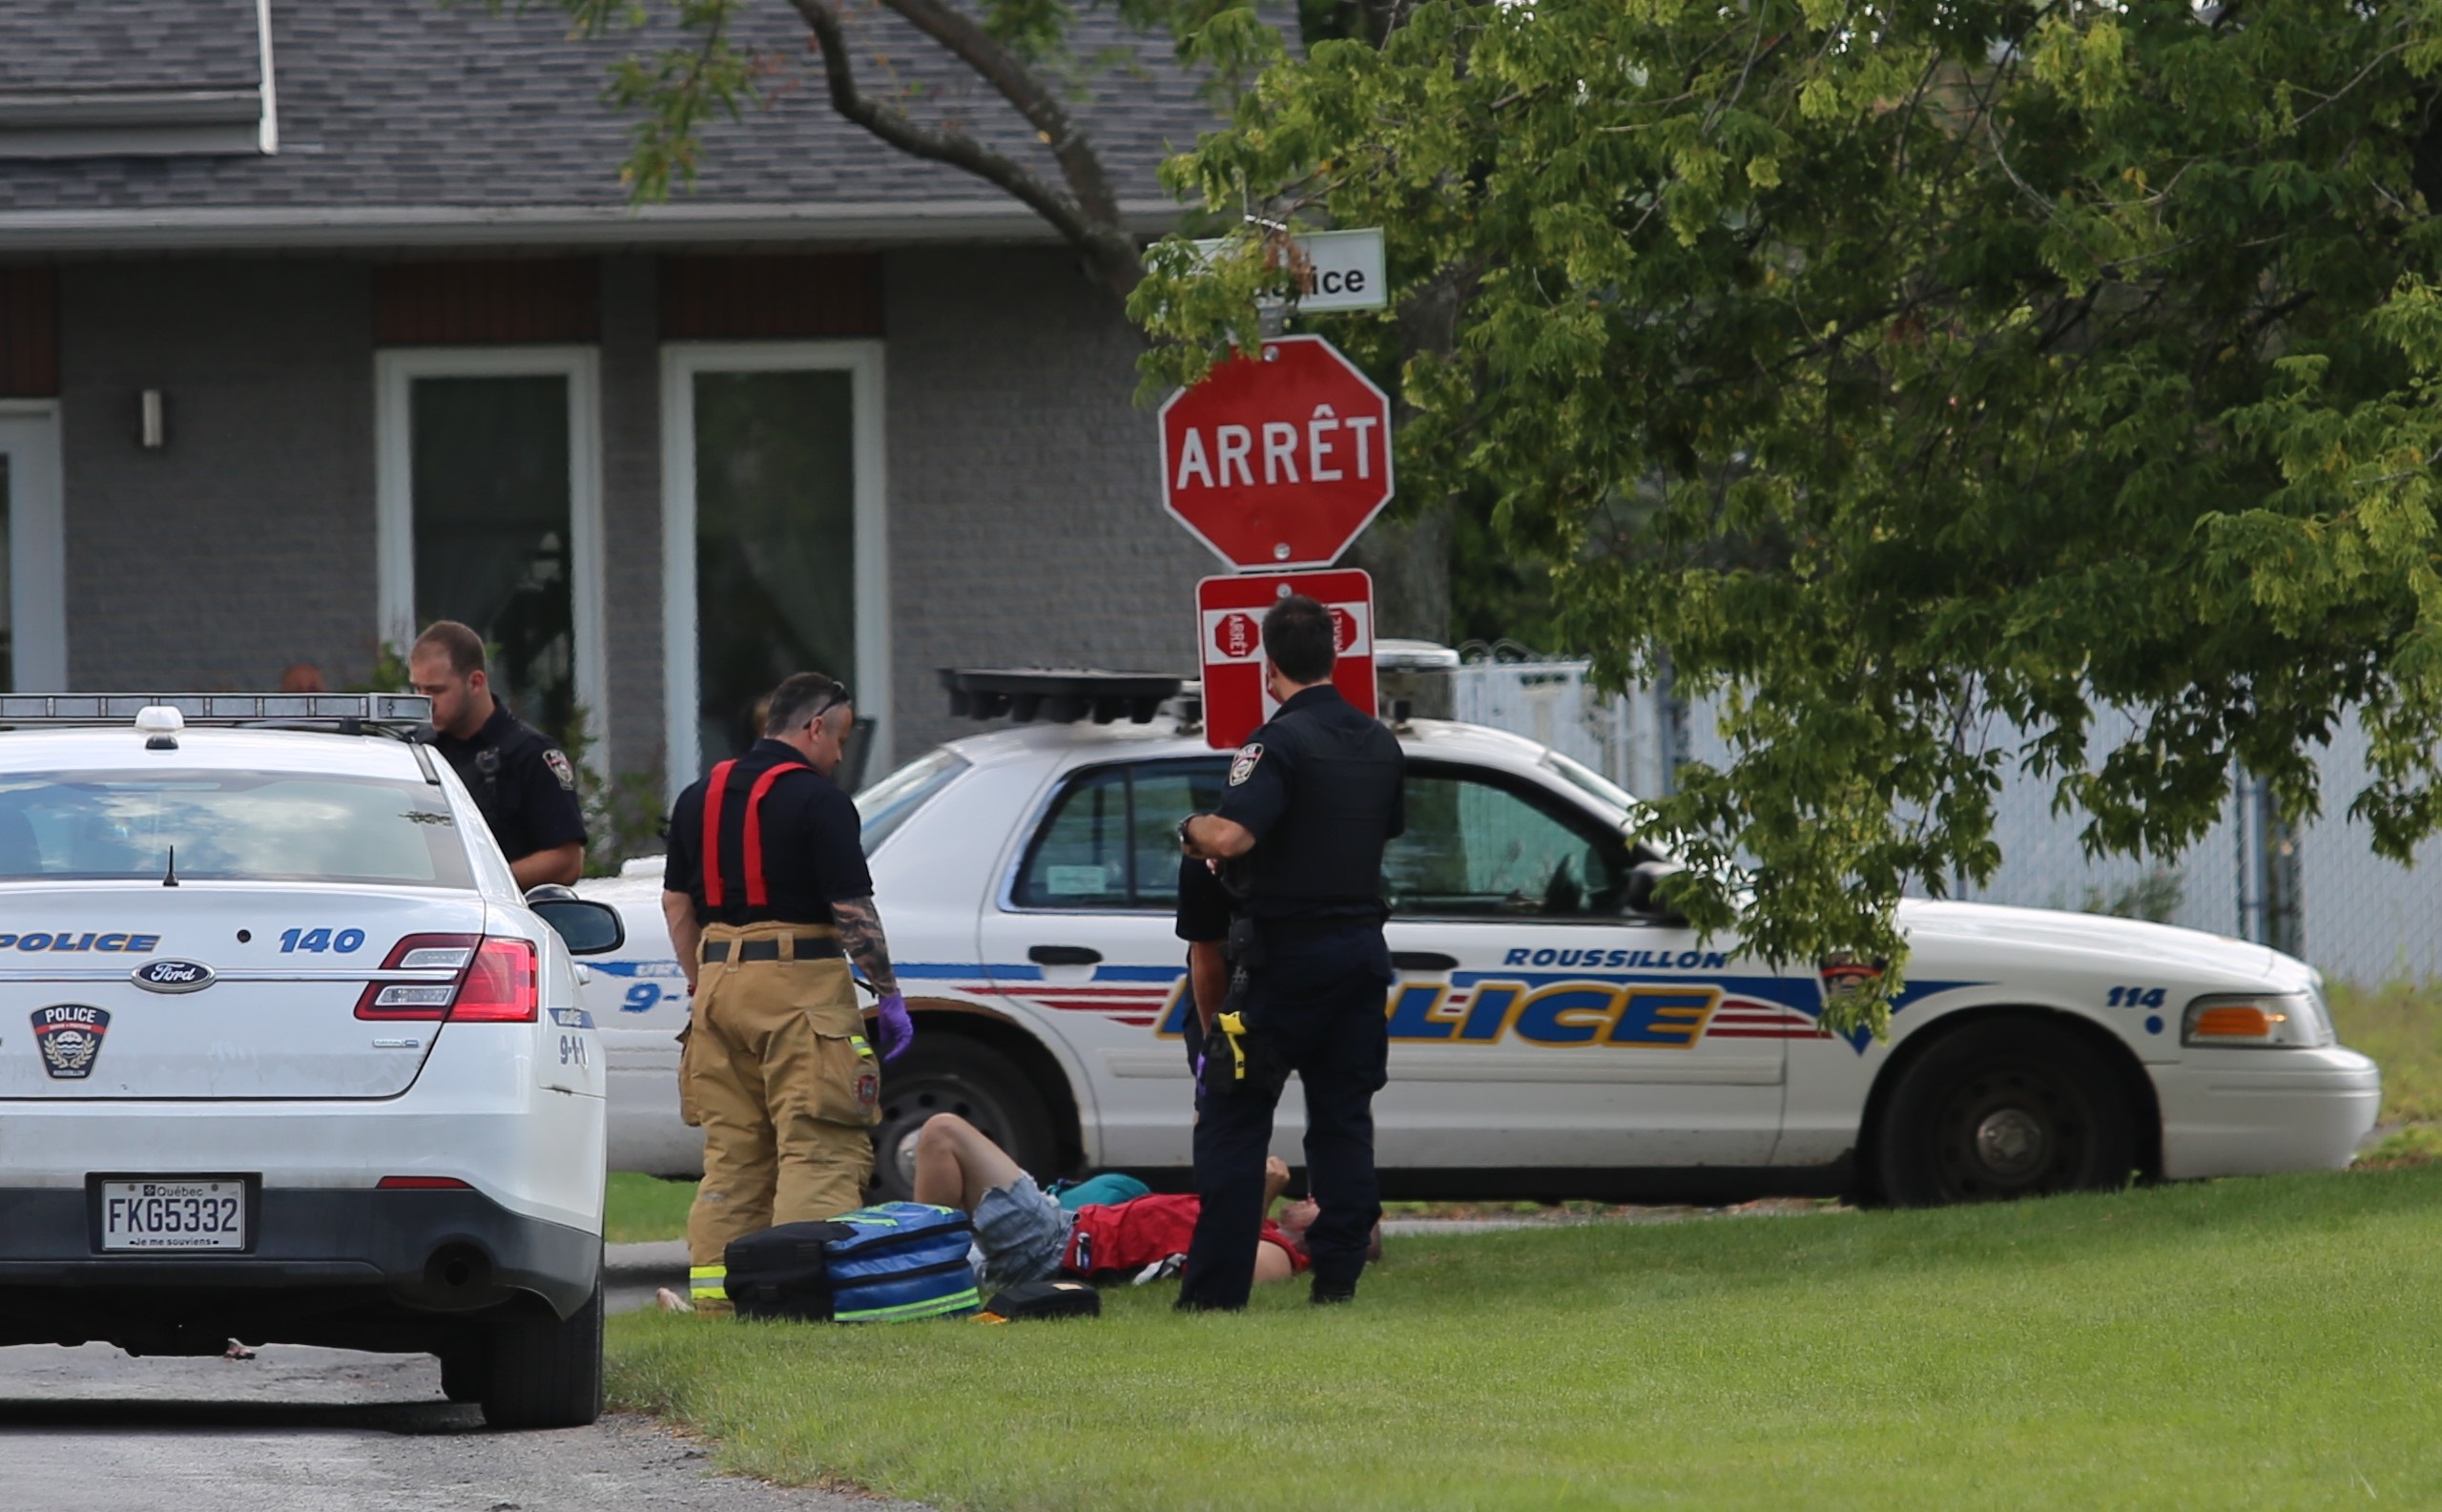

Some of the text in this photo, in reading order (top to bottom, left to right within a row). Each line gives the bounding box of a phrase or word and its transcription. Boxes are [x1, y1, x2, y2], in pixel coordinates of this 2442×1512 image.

[1176, 404, 1377, 489] ARRÊT
[1230, 614, 1249, 656] ARRÊT
[279, 928, 366, 953] 140
[1503, 947, 1728, 969] ROUSSILLON
[150, 963, 196, 982] Ford
[2106, 985, 2167, 1009] 114
[45, 1007, 97, 1024] POLICE
[156, 1186, 204, 1197] Québec
[109, 1198, 238, 1232] FKG5332
